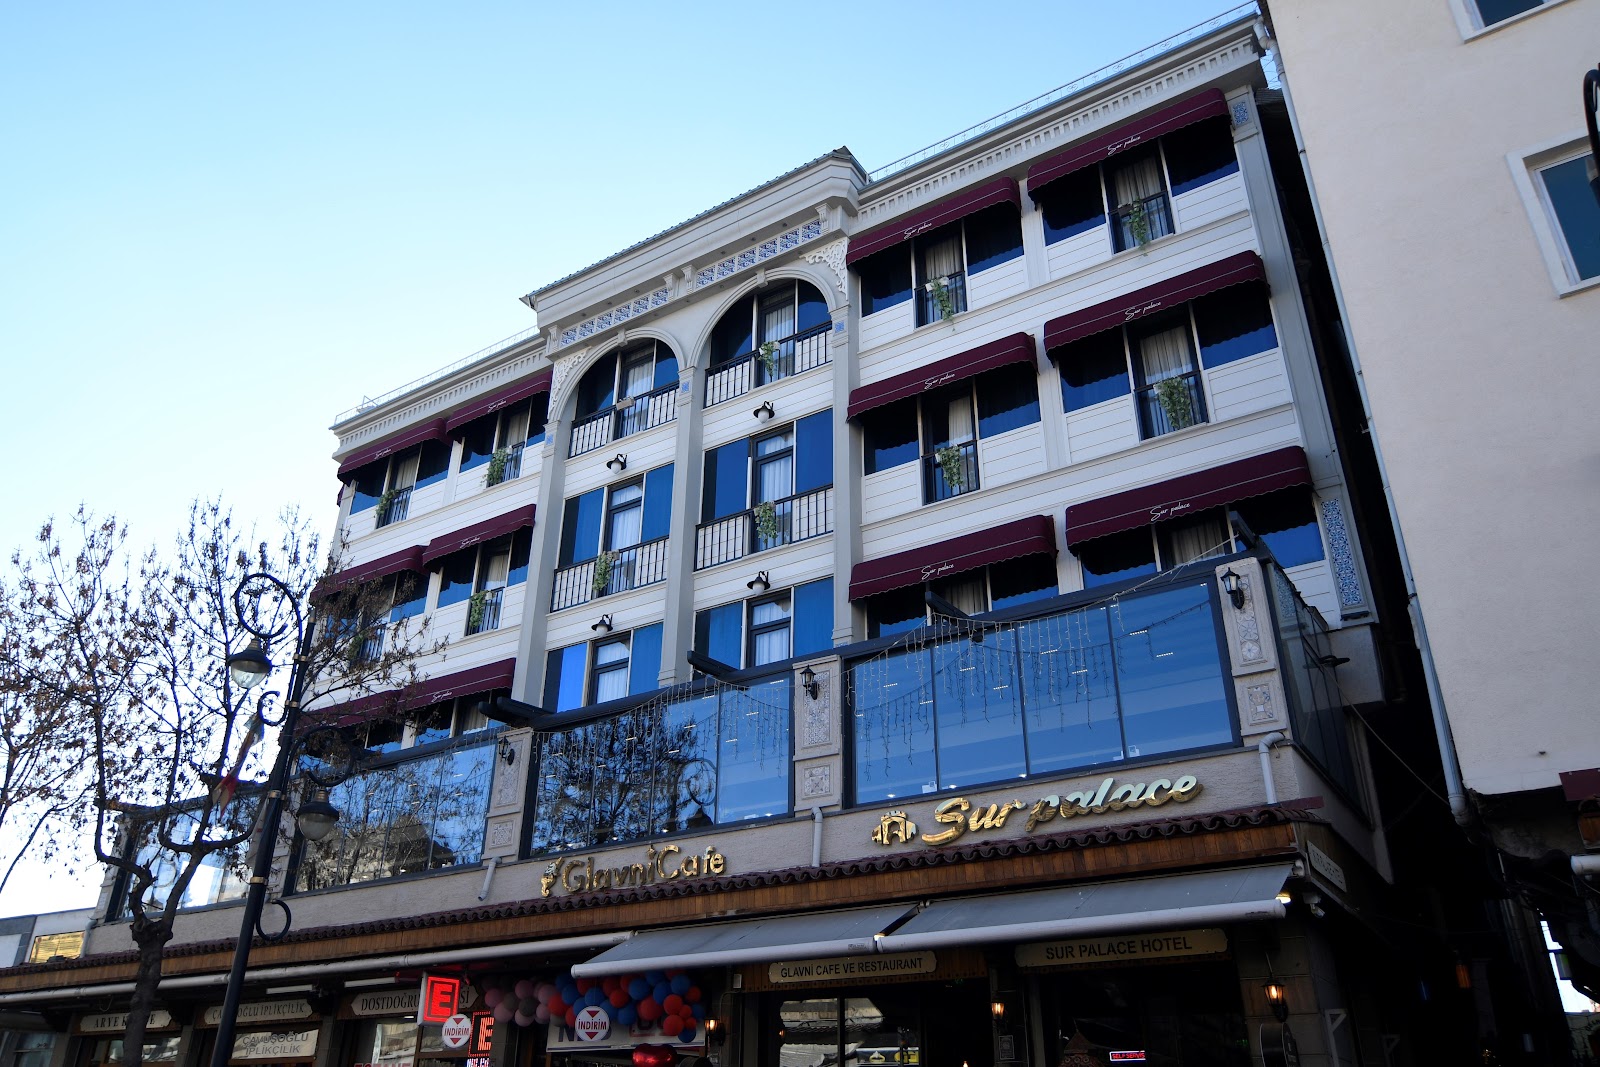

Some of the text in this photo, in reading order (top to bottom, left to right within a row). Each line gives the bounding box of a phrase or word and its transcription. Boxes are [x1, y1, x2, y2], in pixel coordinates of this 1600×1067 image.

[921, 777, 1203, 846] Sur palace
[1046, 936, 1192, 960] SUR PALACE HOTEL
[781, 957, 923, 978] GLAVNİ CAFE VE RESTAURANT
[444, 1025, 470, 1037] İNDİRİM
[578, 1018, 607, 1030] İNDİRİM
